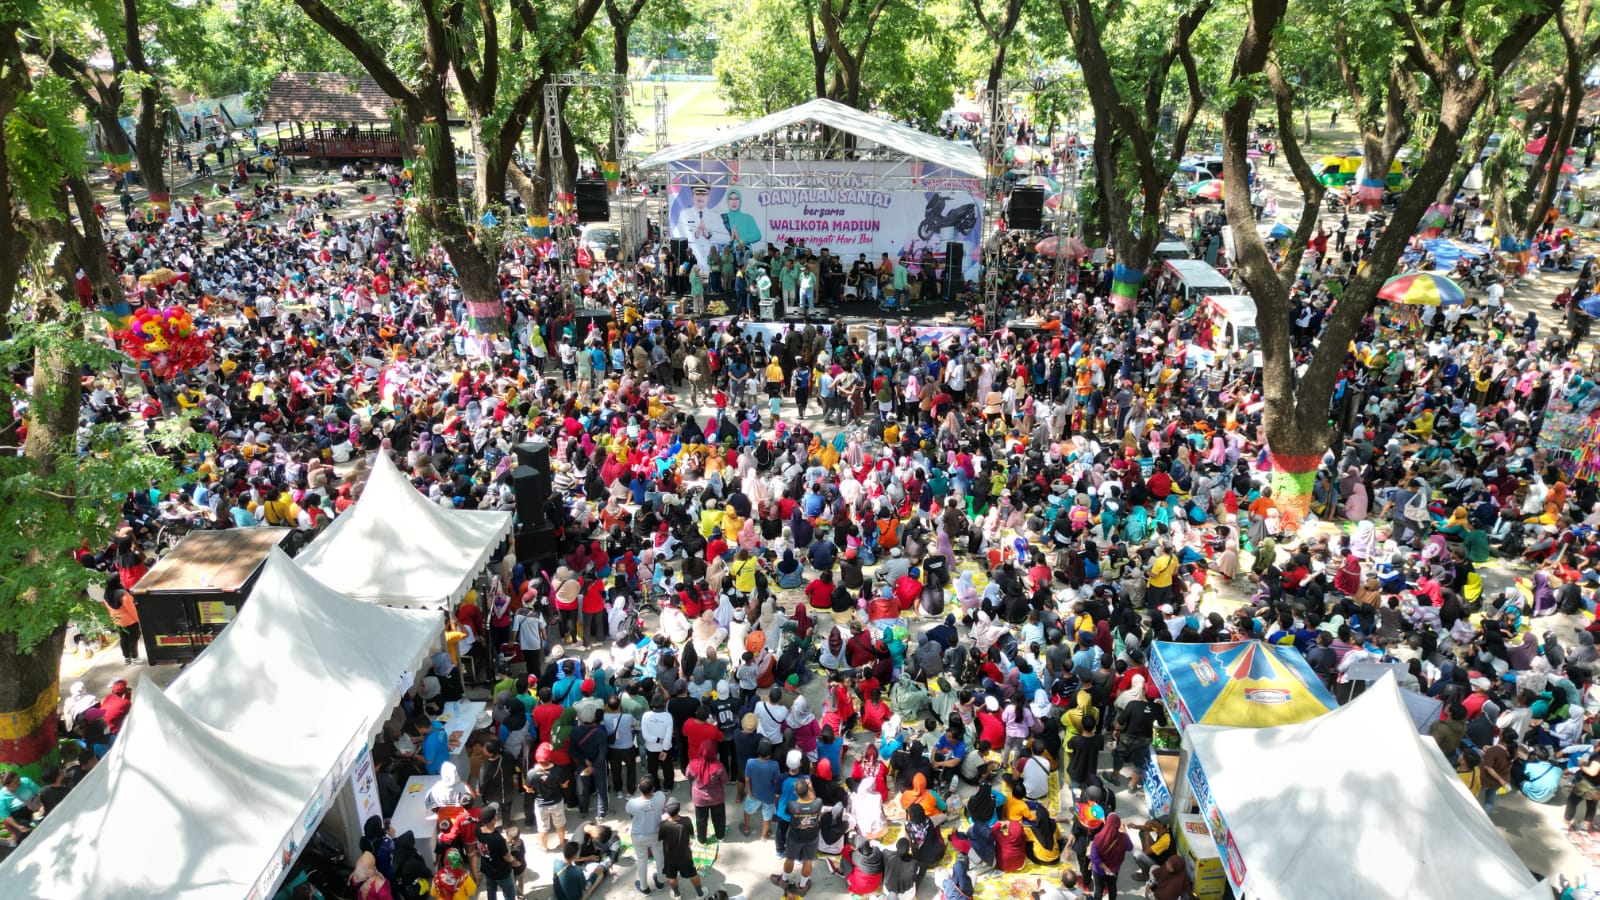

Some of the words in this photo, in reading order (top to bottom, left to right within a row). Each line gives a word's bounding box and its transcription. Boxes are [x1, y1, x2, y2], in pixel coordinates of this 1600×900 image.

[760, 190, 791, 206] DAN
[792, 189, 836, 206] JALAN
[838, 190, 891, 208] SANTAI
[803, 205, 846, 217] bersama
[769, 219, 829, 231] WALIKOTA
[832, 219, 880, 231] MADIUN
[837, 234, 857, 244] Hari
[859, 234, 873, 244] Ibu
